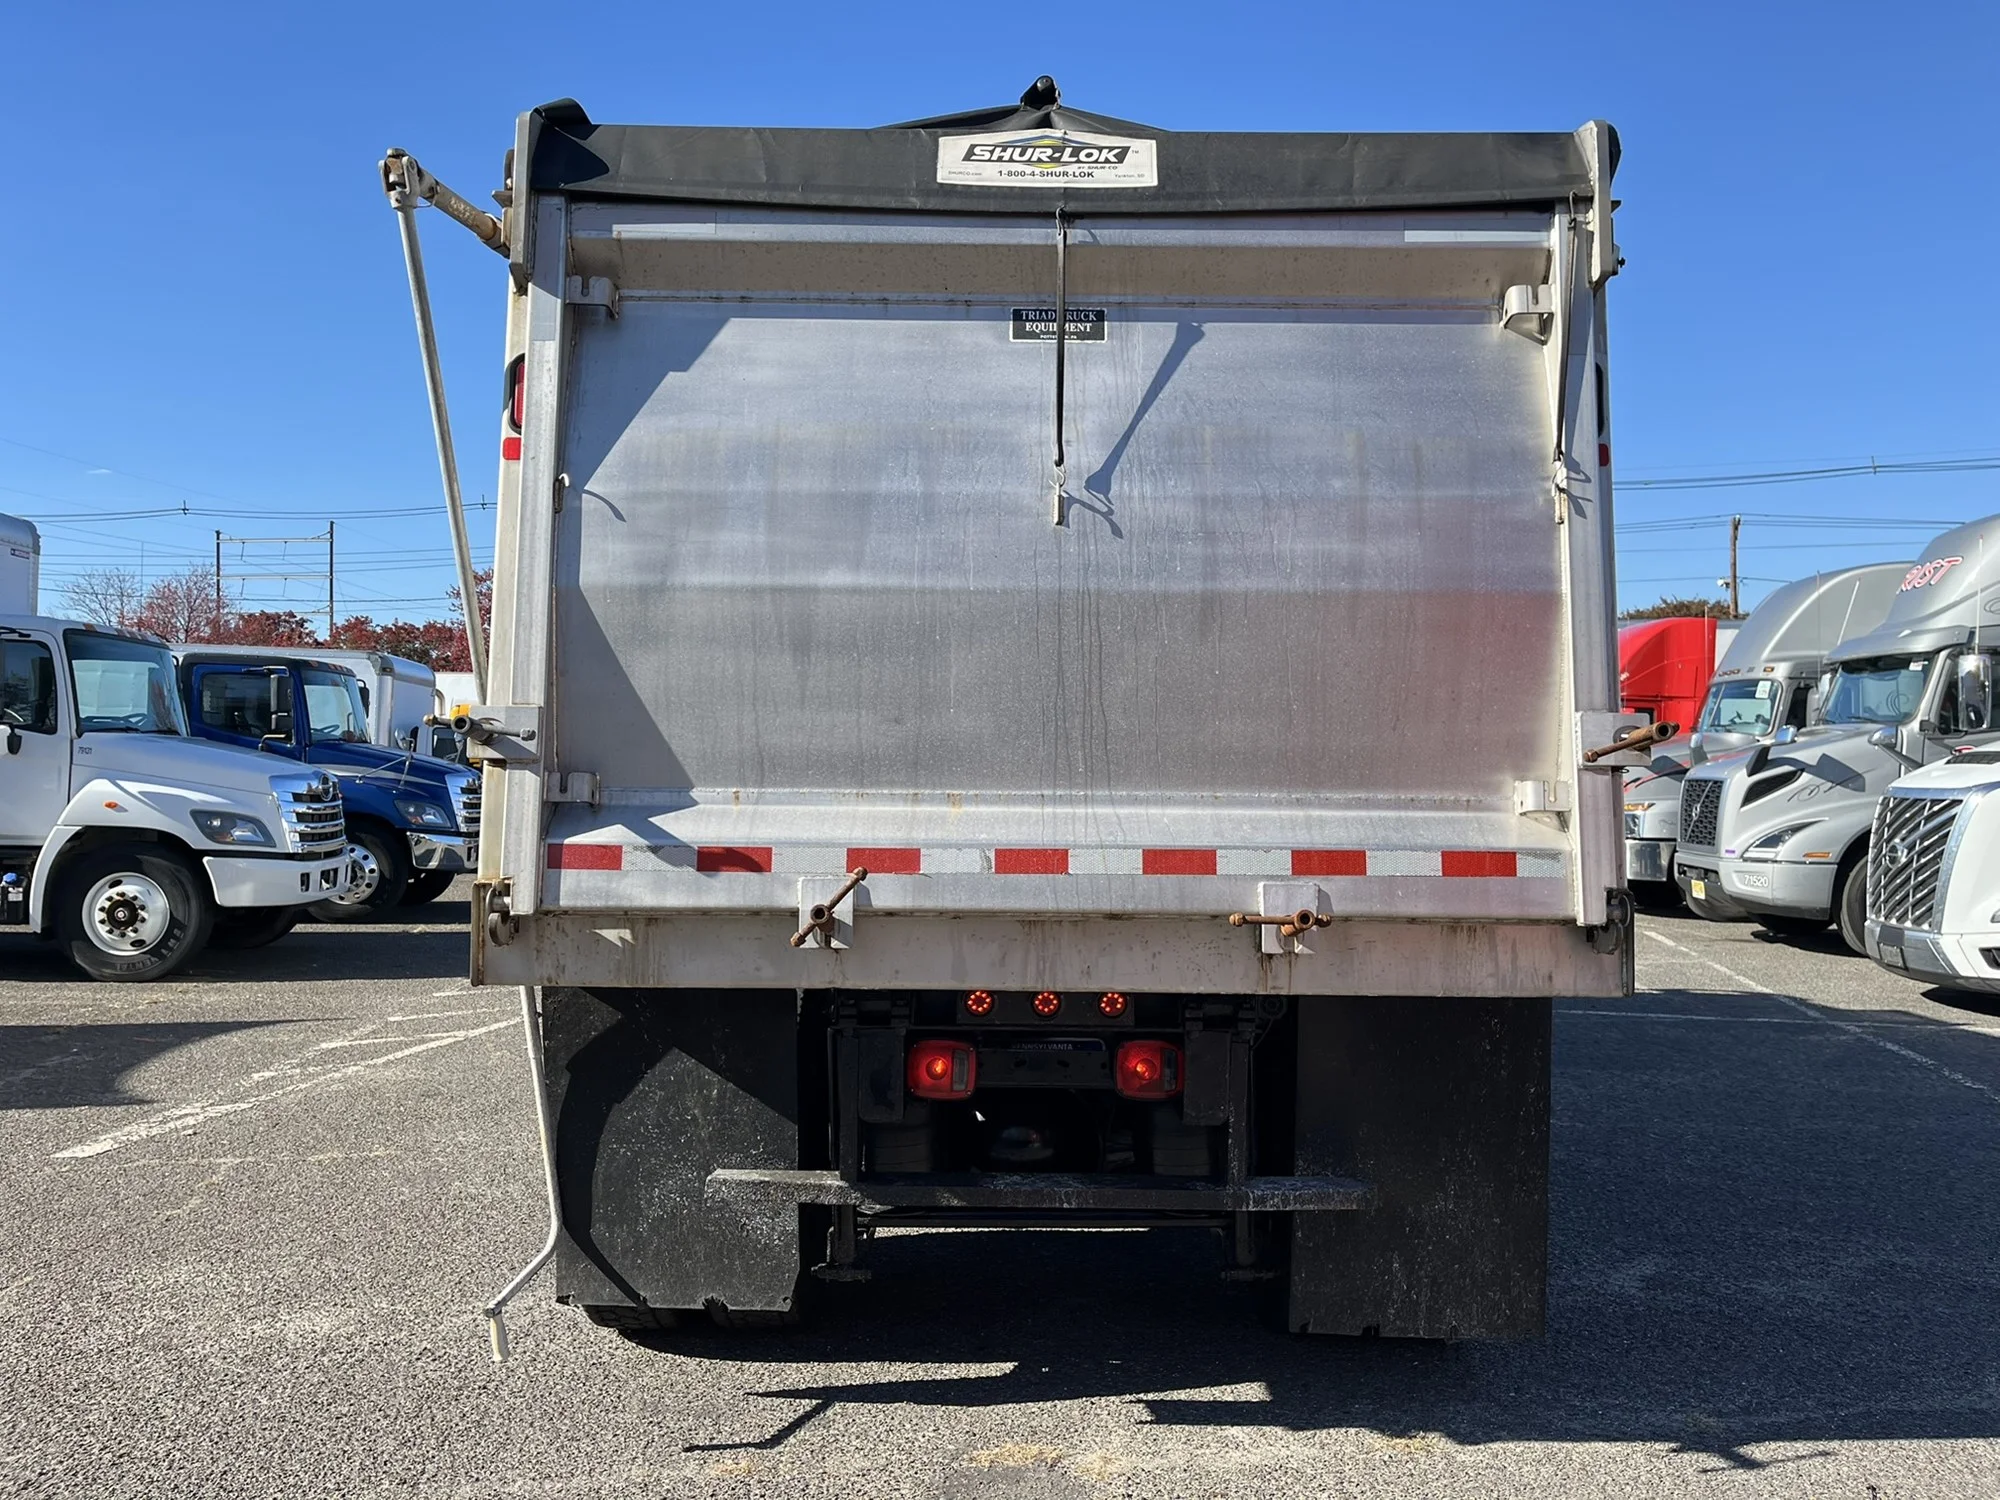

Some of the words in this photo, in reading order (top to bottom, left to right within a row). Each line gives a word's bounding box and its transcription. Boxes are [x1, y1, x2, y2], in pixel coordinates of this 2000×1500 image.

[970, 145, 1122, 163] SHUR-LOK
[998, 170, 1095, 178] 1-800-4-SHUR-LOK
[1021, 310, 1056, 320] TRIAD
[1064, 311, 1097, 321] RUCK
[1025, 322, 1093, 333] EQUIMENT
[1744, 874, 1769, 887] 71520
[1011, 1043, 1073, 1051] ENNSYLVANIA
